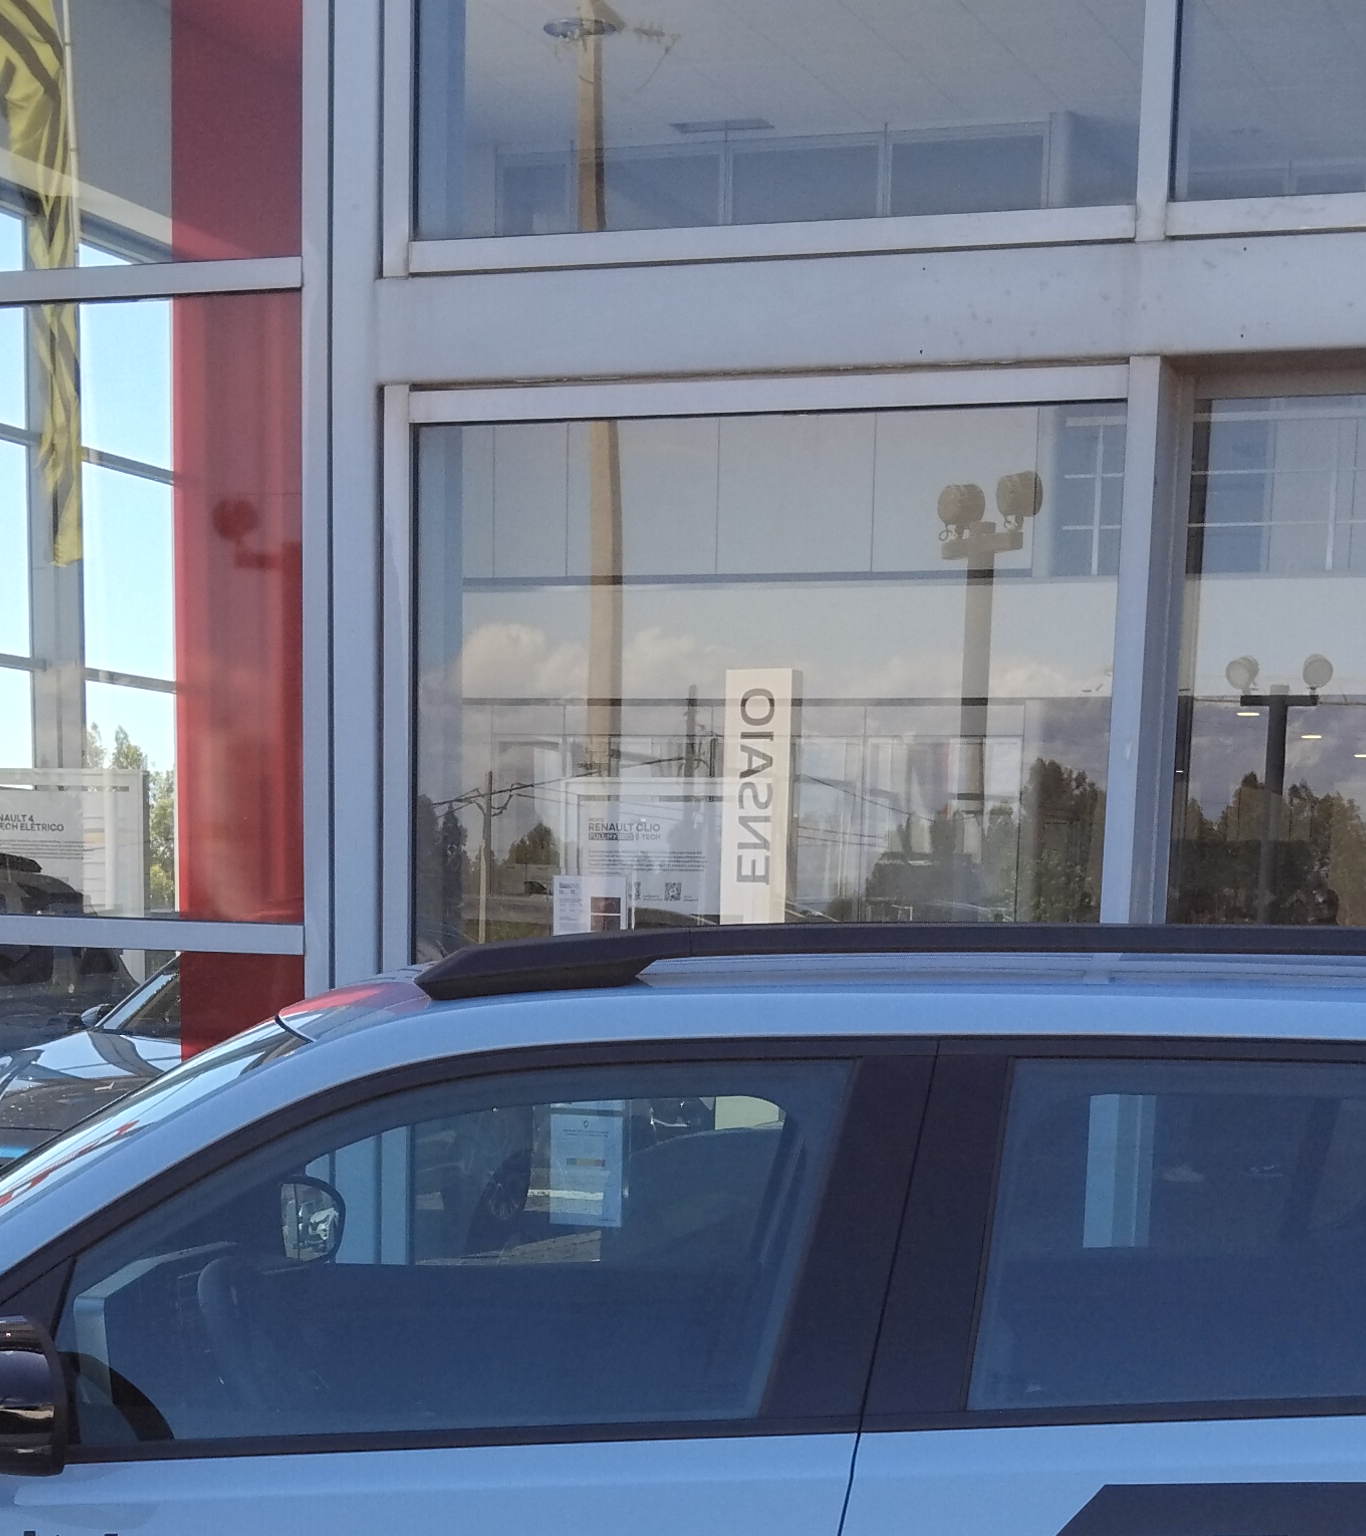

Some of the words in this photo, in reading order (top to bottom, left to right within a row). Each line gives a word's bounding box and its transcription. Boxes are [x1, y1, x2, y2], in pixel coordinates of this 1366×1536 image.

[28, 814, 35, 823] 4
[588, 822, 634, 832] RENAULT
[636, 822, 661, 832] CLIO
